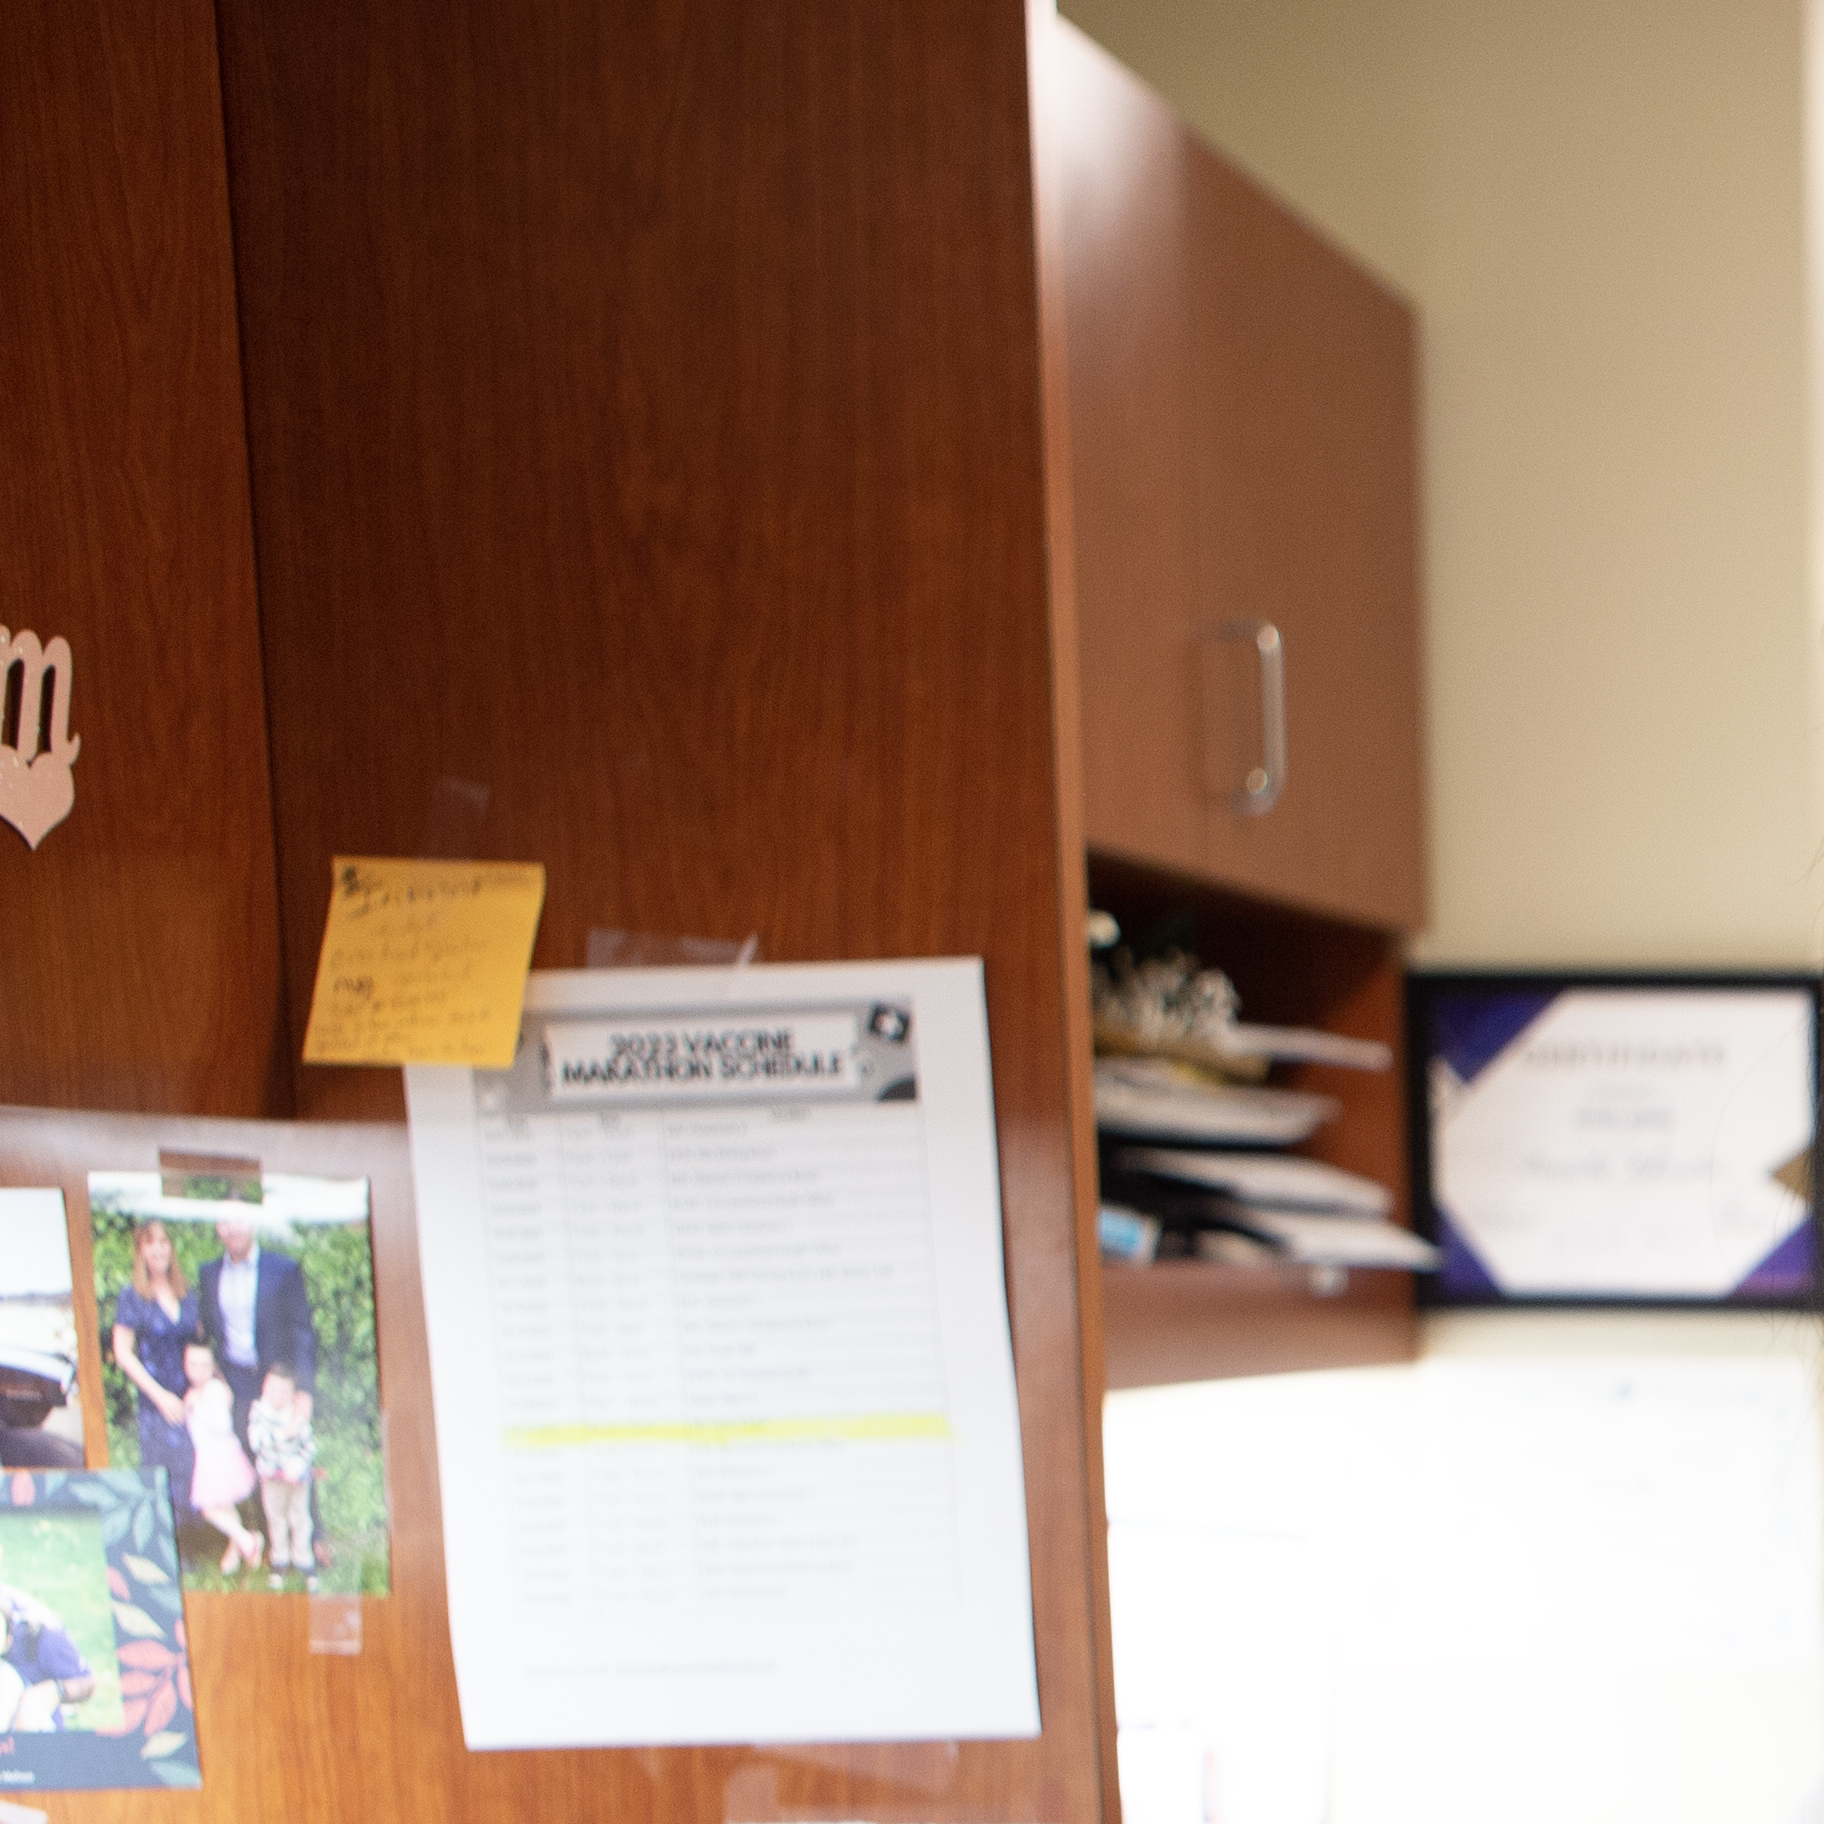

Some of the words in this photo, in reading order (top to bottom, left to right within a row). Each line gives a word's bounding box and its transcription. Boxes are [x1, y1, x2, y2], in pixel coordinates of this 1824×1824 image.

[683, 1026, 796, 1055] VACCINE
[562, 1055, 711, 1086] MARATHON
[718, 1049, 842, 1078] SCHEDULE
